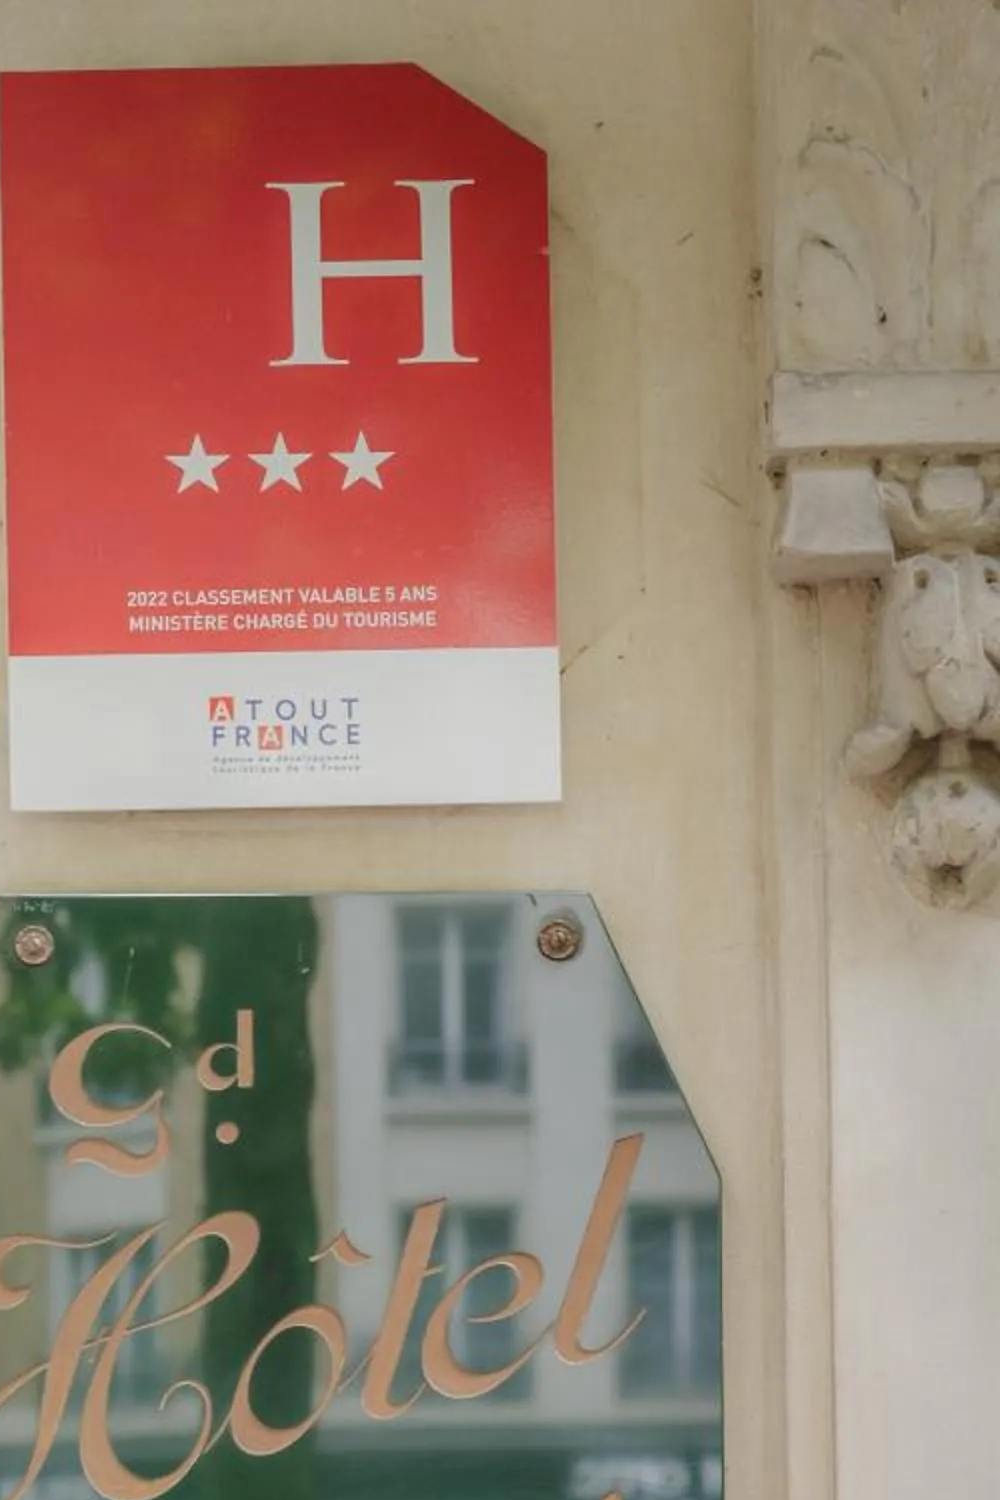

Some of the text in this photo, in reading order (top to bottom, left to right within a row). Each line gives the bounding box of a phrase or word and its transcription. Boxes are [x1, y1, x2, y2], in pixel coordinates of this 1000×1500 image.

[265, 177, 480, 367] H
[127, 585, 438, 607] 2022 CLASSEMENT VALABLE 5 ANS
[129, 608, 438, 632] MINISTÈRE CHARGÉ DU TOURISME
[209, 697, 360, 721] ATOUT
[212, 723, 361, 750] FRANCE
